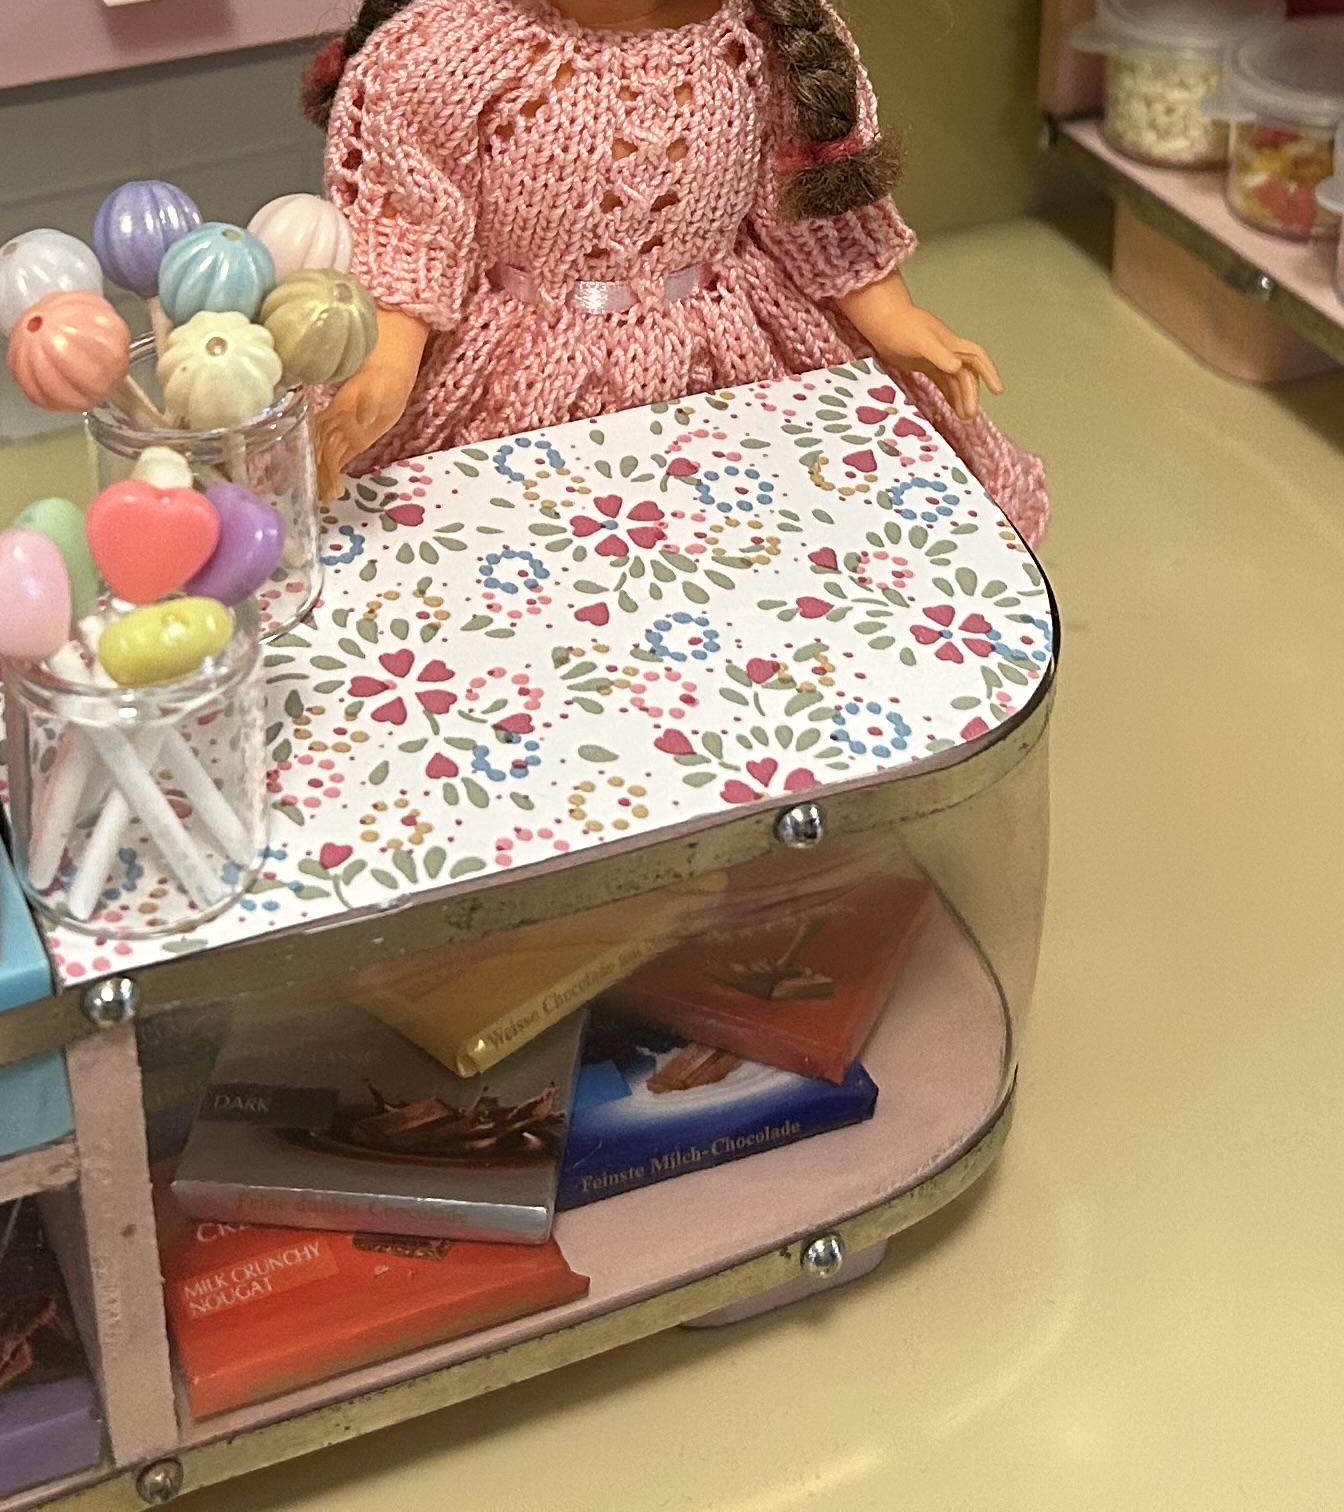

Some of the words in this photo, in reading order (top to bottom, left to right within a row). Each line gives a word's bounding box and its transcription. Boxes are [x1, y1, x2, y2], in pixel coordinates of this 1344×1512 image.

[213, 1094, 271, 1114] DARK
[580, 1164, 646, 1194] Feinste
[649, 1118, 802, 1174] Milch-Chocolade
[184, 1272, 228, 1300] MILK
[231, 1240, 321, 1283] CRUNCHY
[189, 1276, 273, 1317] NOUGAT
